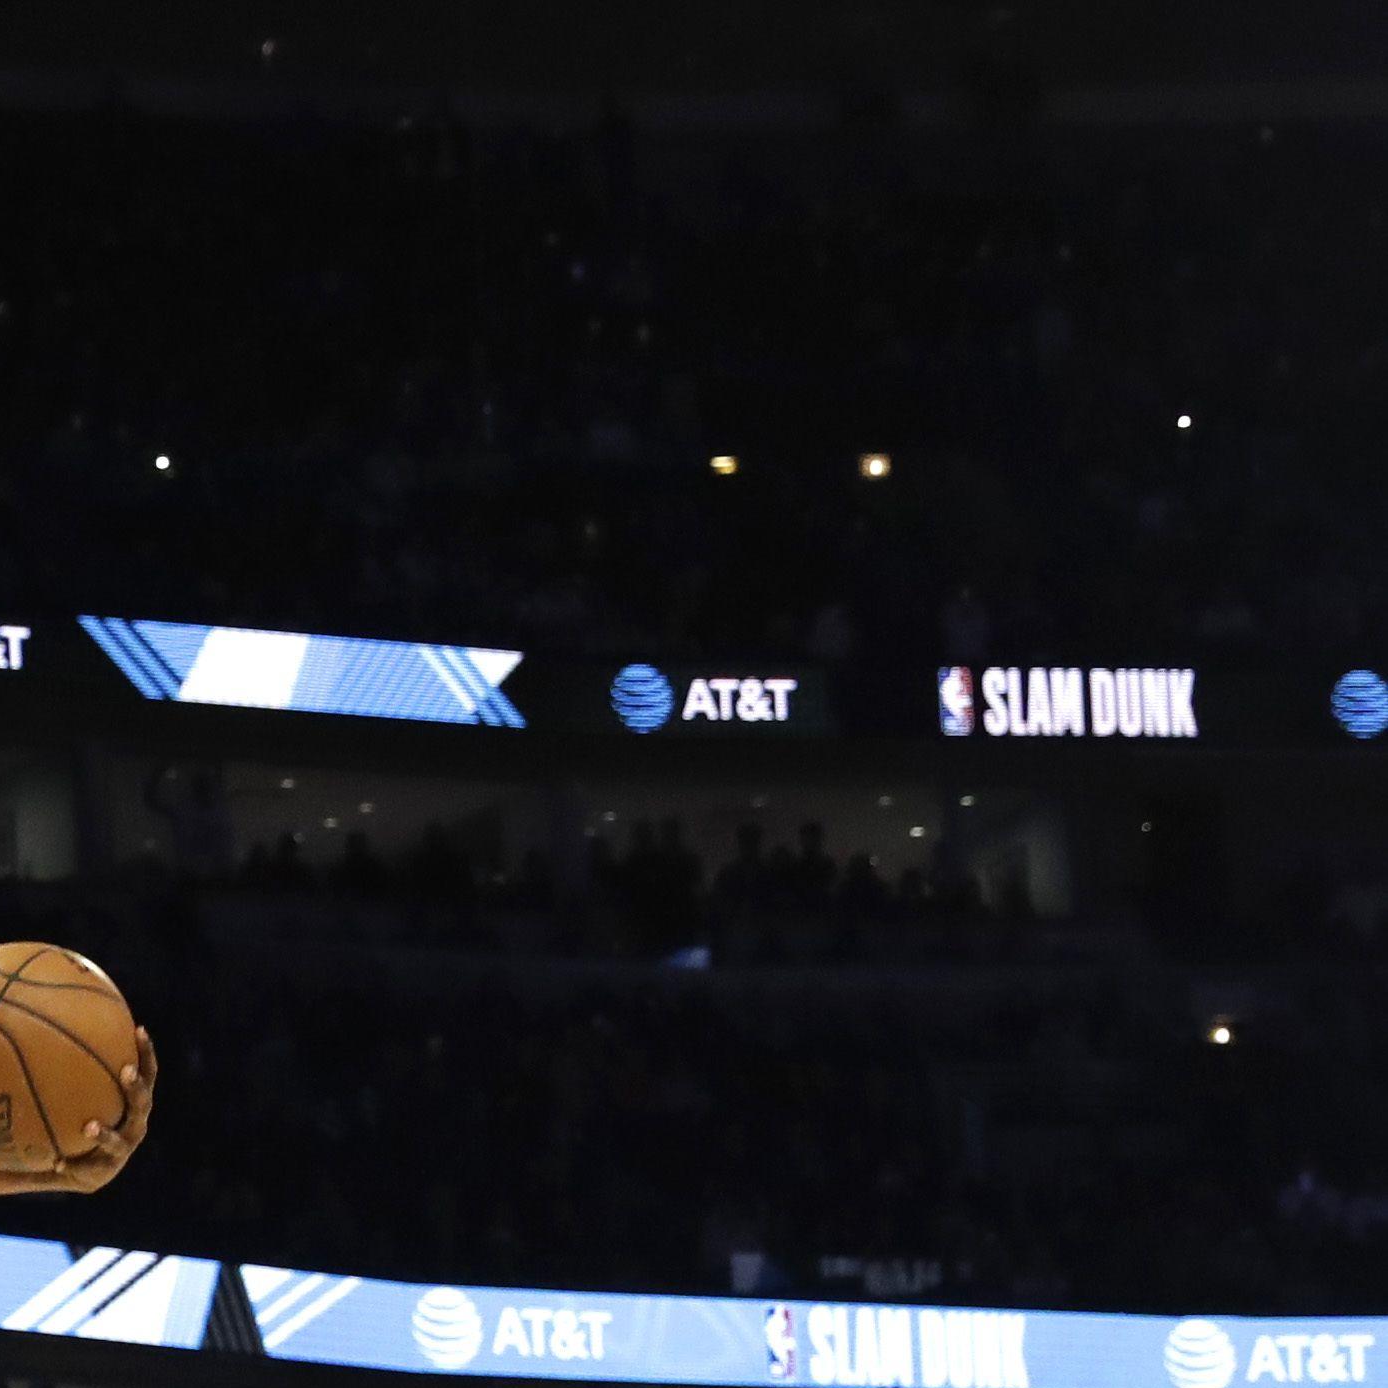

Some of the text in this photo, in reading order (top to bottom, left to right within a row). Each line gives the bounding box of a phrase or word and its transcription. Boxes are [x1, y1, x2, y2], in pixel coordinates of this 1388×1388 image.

[682, 677, 797, 722] AT&T
[983, 667, 1198, 738] SLAM DUNK
[492, 1307, 613, 1361] AT&T
[807, 1305, 914, 1388] SLAM
[1247, 1333, 1375, 1383] AT&T
